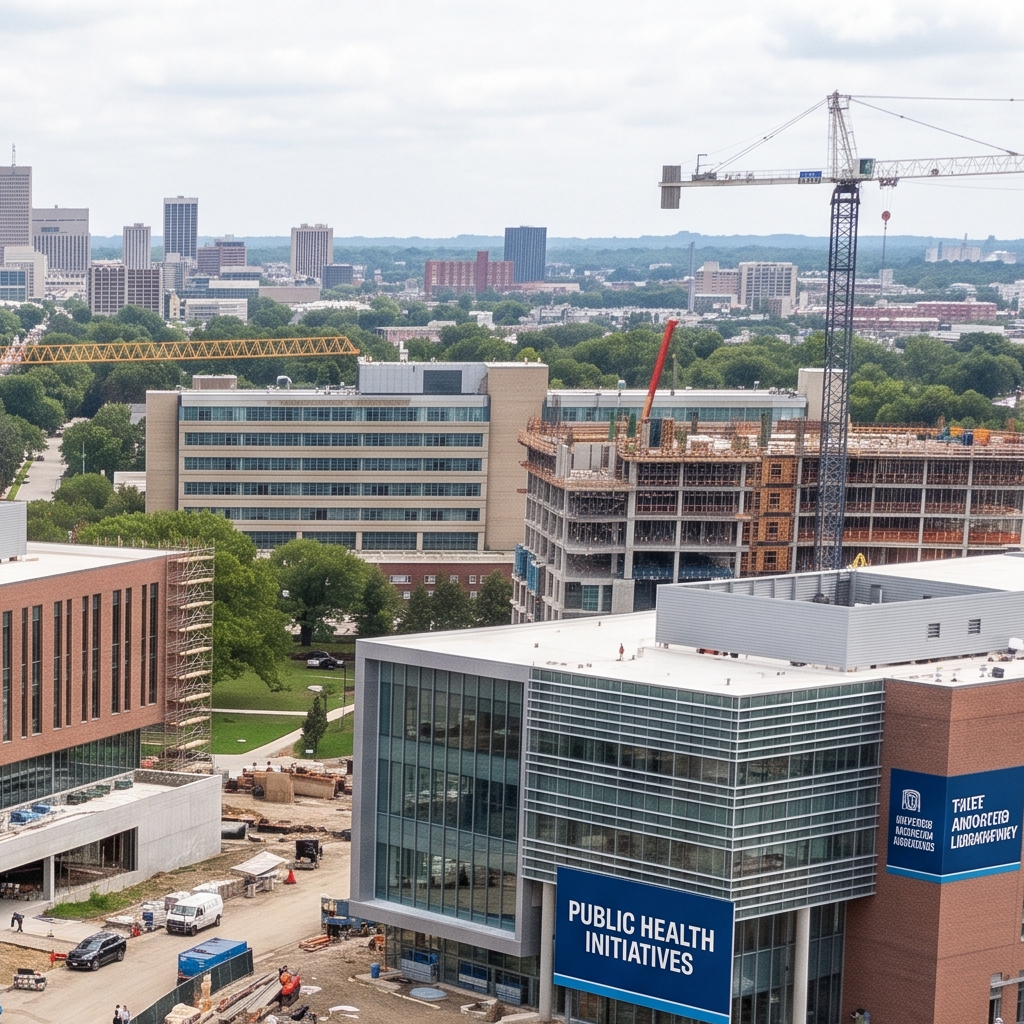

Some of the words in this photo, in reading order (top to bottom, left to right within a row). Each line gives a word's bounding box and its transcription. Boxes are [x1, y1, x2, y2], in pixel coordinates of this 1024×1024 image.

[568, 899, 635, 935] PUBLIC
[640, 915, 715, 953] HEALTH
[585, 930, 694, 976] INITIATIVES
